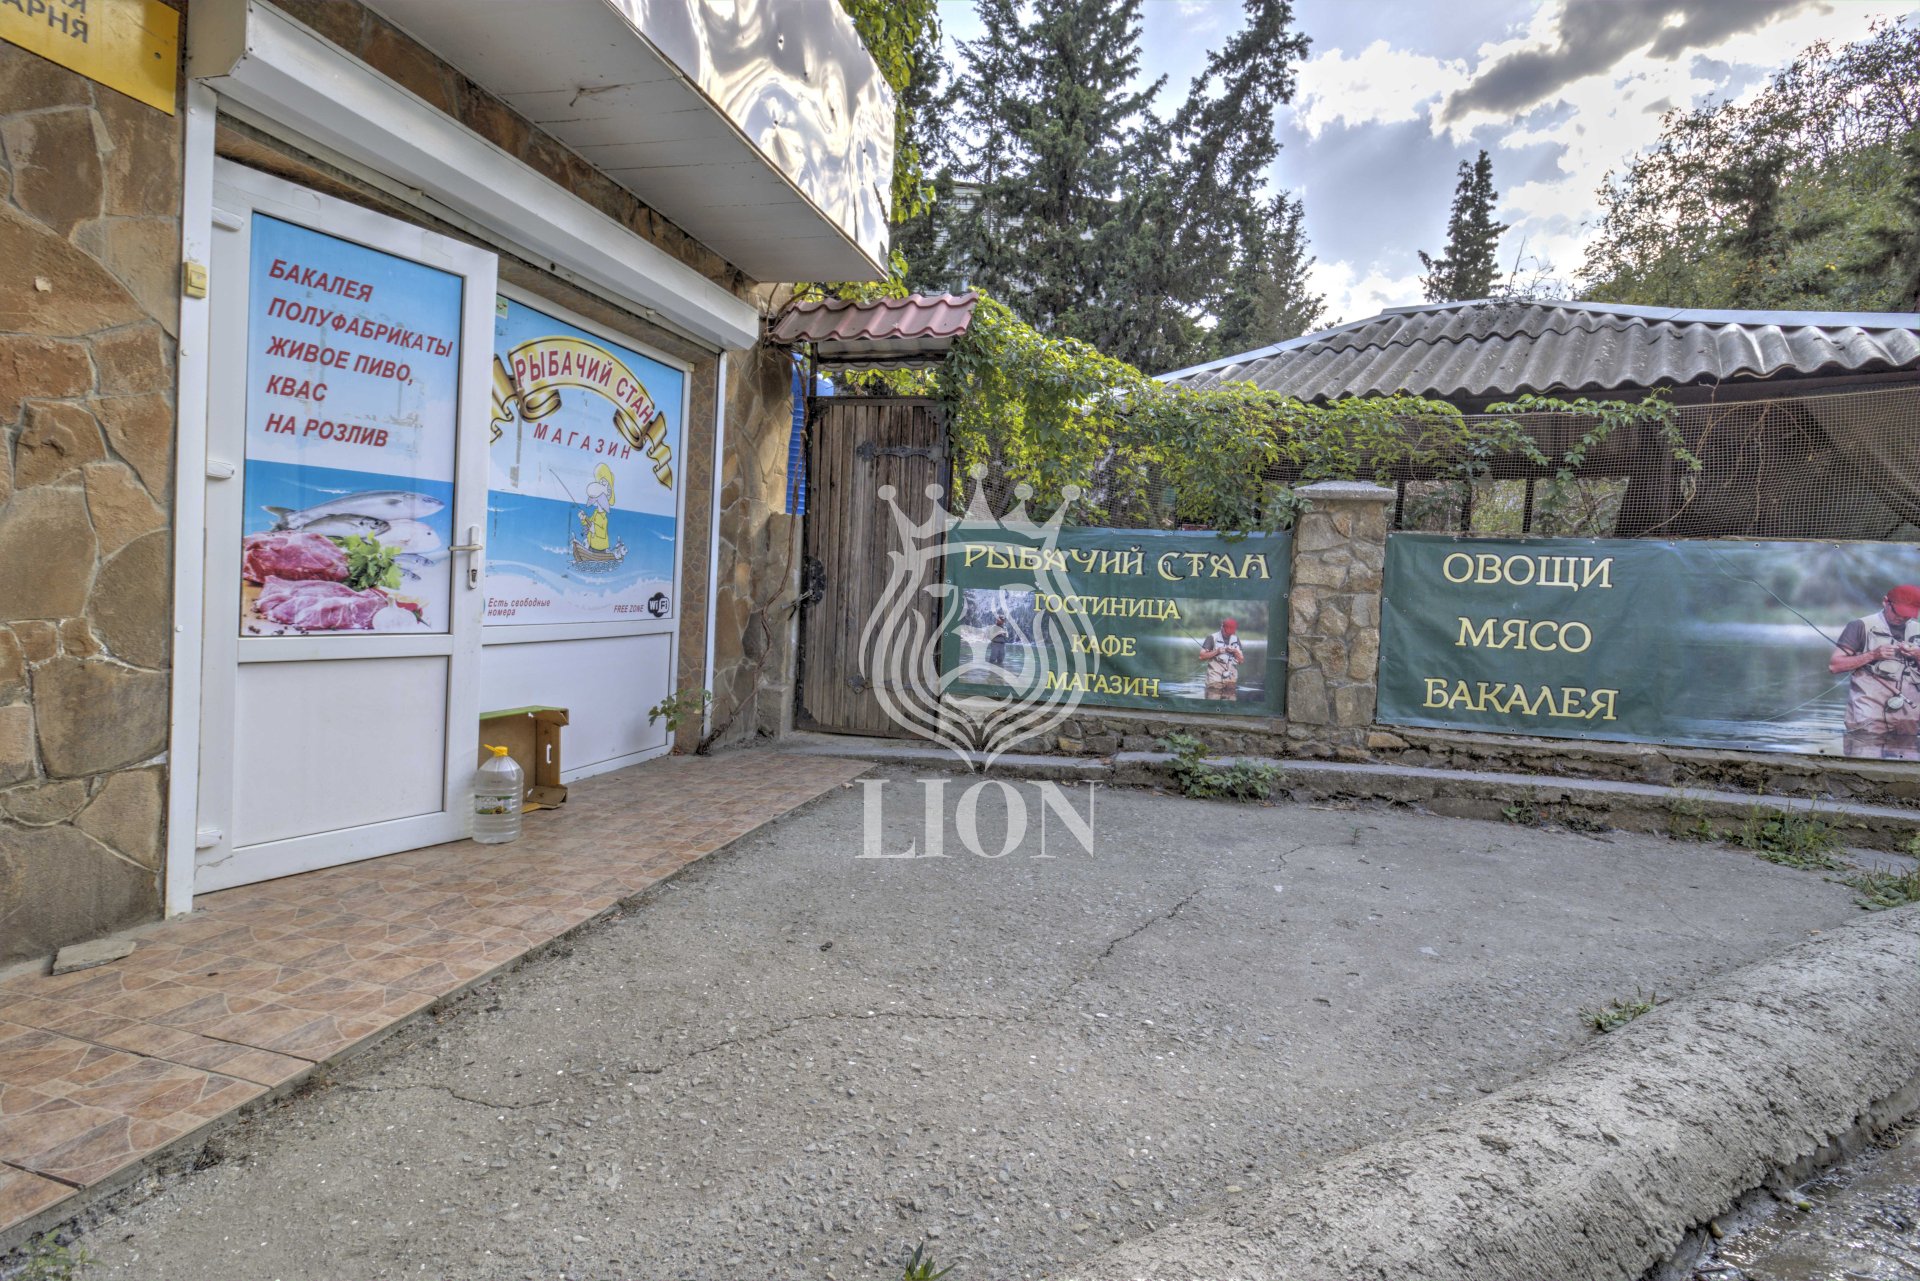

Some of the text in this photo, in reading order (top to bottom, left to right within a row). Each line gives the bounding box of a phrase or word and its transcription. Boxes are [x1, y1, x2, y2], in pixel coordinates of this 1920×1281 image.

[268, 258, 374, 302] БАКАЛЕЯ
[267, 297, 454, 358] ПОЛУФАБРИКАТЫ
[265, 335, 414, 386] ЖИВОЕ ПИВО,
[265, 374, 328, 402] КВАС
[515, 350, 655, 425] РЫБАЧИЙ СТАН
[265, 413, 389, 447] НА РОЗЛИВ
[533, 422, 632, 460] МАГАЗИН
[963, 544, 1146, 576] РЫБАЧИЙ
[1442, 552, 1614, 592] ОВОЩИ
[487, 597, 509, 608] Есть
[487, 608, 516, 618] номера
[613, 604, 628, 614] FREE
[629, 605, 644, 613] ZONE
[1033, 592, 1182, 621] ГОСТИНИЦА
[1071, 633, 1137, 657] КАФЕ
[1454, 616, 1593, 653] МЯСО
[1045, 670, 1161, 698] МАГАЗИН
[1422, 677, 1620, 722] БАКАЛЕЯ
